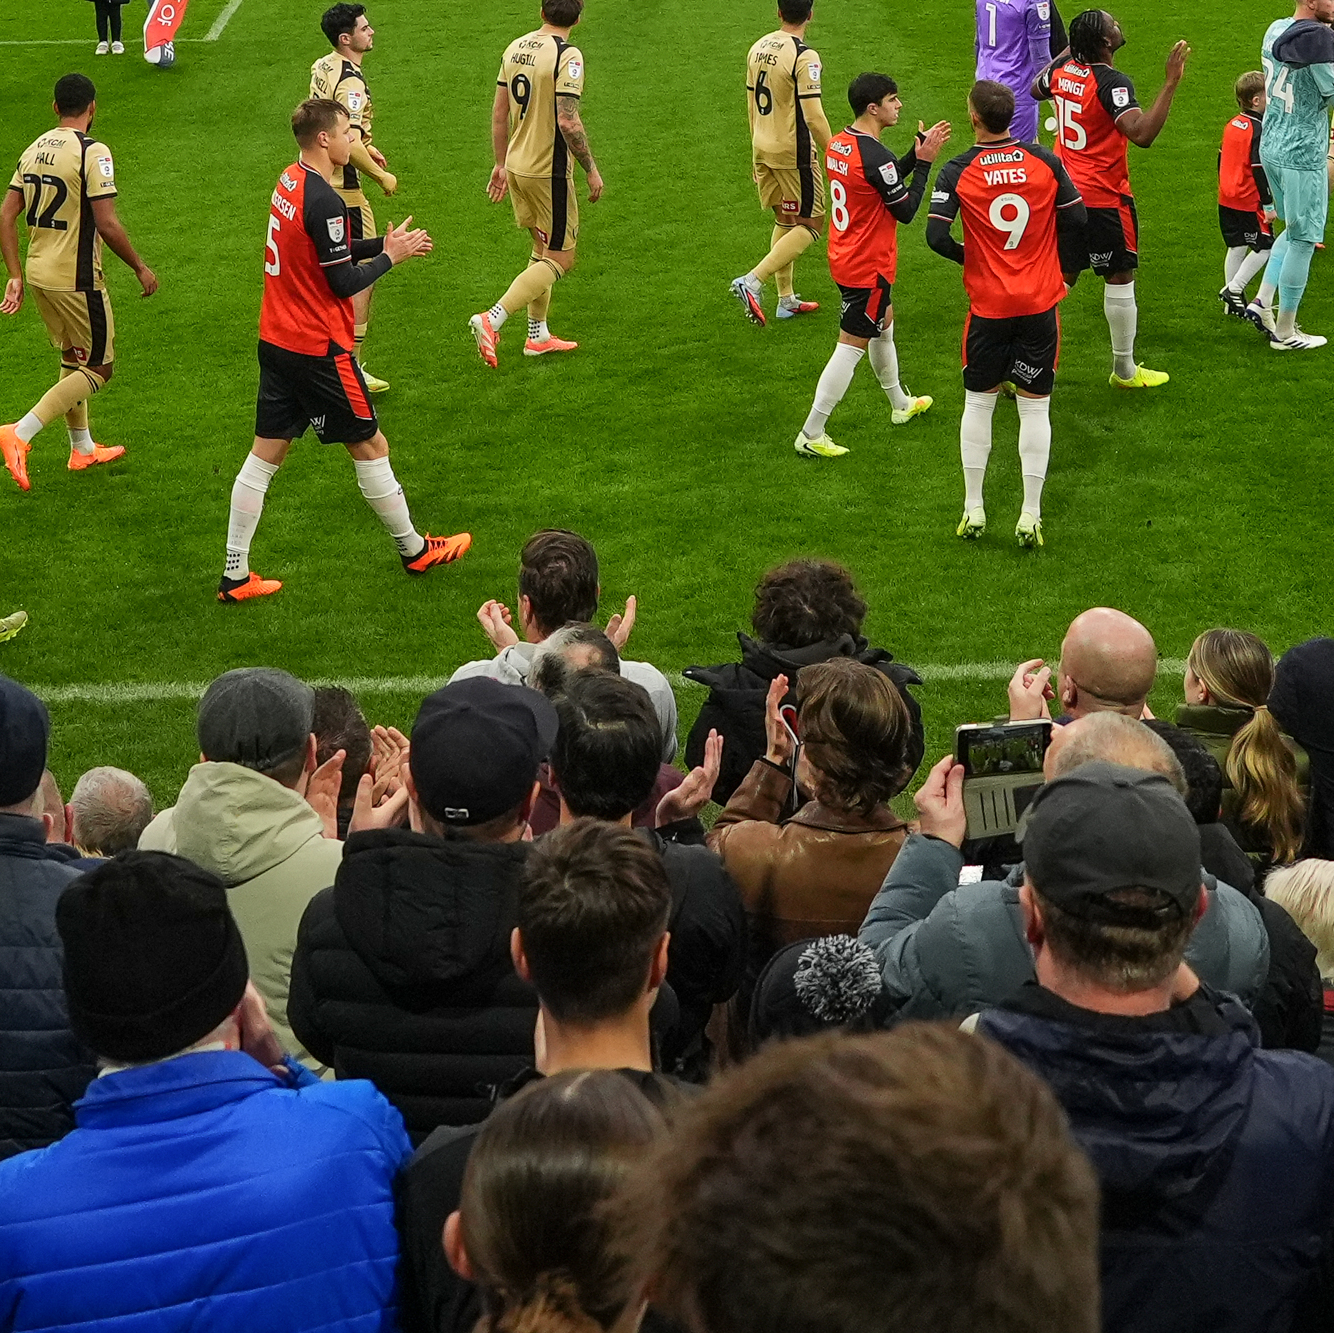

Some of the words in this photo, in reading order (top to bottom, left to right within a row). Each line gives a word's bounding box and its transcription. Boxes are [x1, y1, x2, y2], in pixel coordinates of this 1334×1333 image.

[157, 4, 175, 27] OF
[985, 2, 996, 47] 1
[510, 53, 536, 67] HUGILL
[511, 73, 531, 120] 9
[755, 70, 772, 115] 6
[1058, 77, 1085, 96] MENGI
[1055, 95, 1087, 150] 15
[979, 153, 1014, 166] utilita
[983, 167, 1027, 186] YATES
[831, 179, 850, 232] 8
[988, 193, 1030, 250] 9
